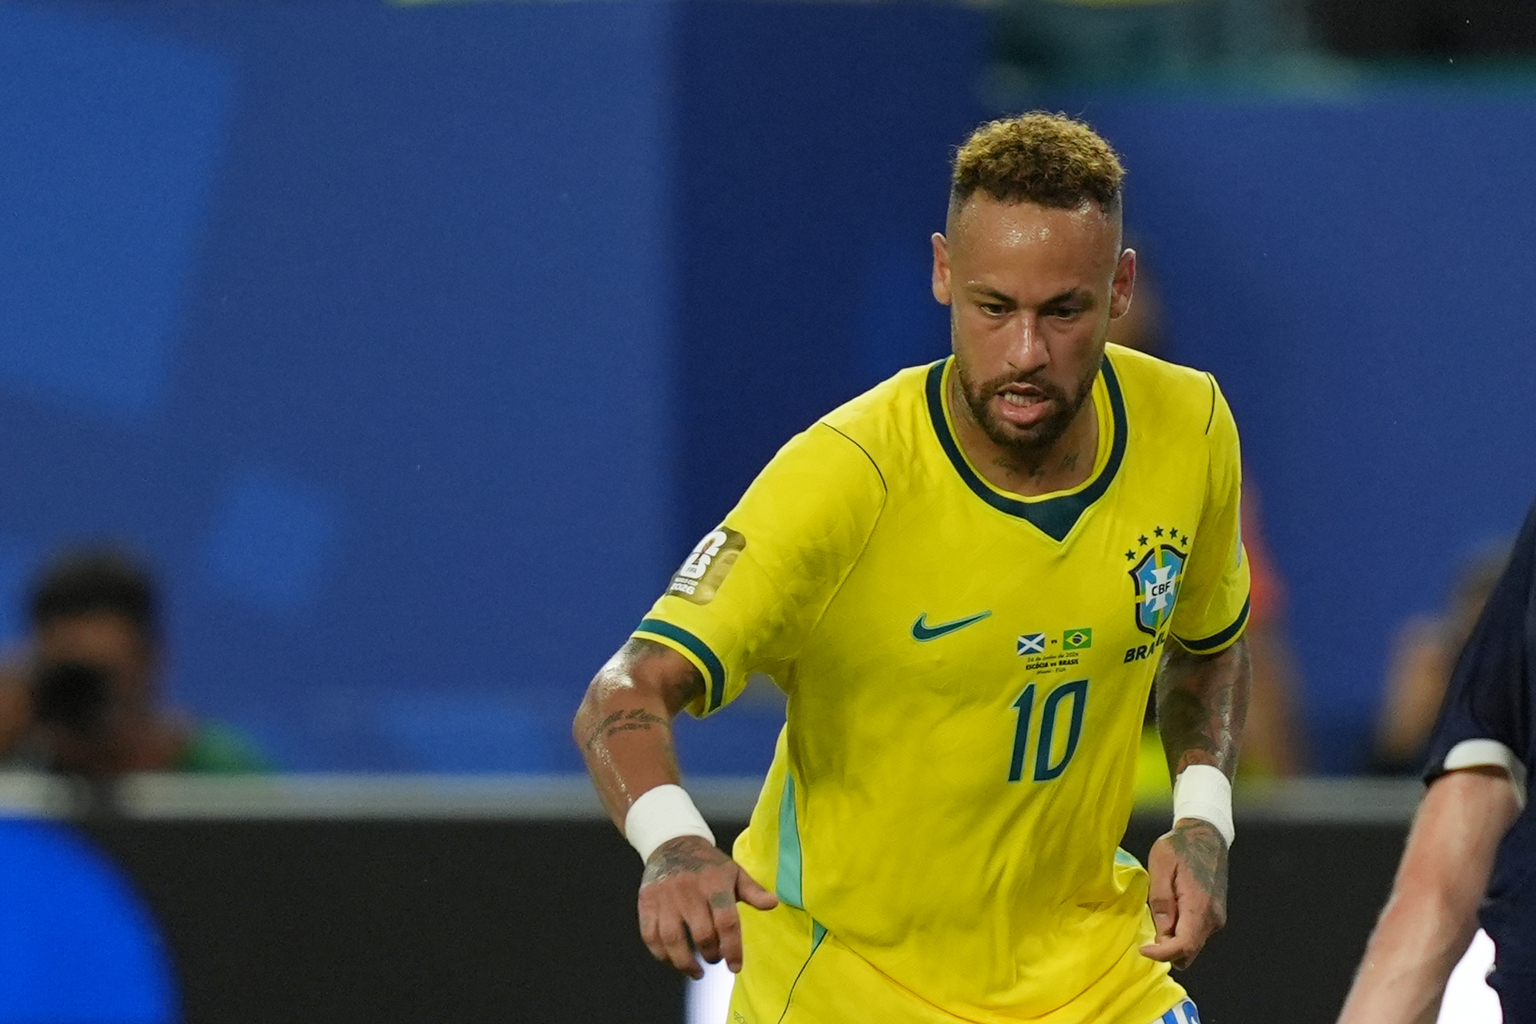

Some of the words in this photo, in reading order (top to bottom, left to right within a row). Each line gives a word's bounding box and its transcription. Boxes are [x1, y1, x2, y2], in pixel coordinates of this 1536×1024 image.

[1151, 581, 1172, 597] CBF
[1123, 630, 1166, 664] BRAIL
[1007, 679, 1089, 783] 10
